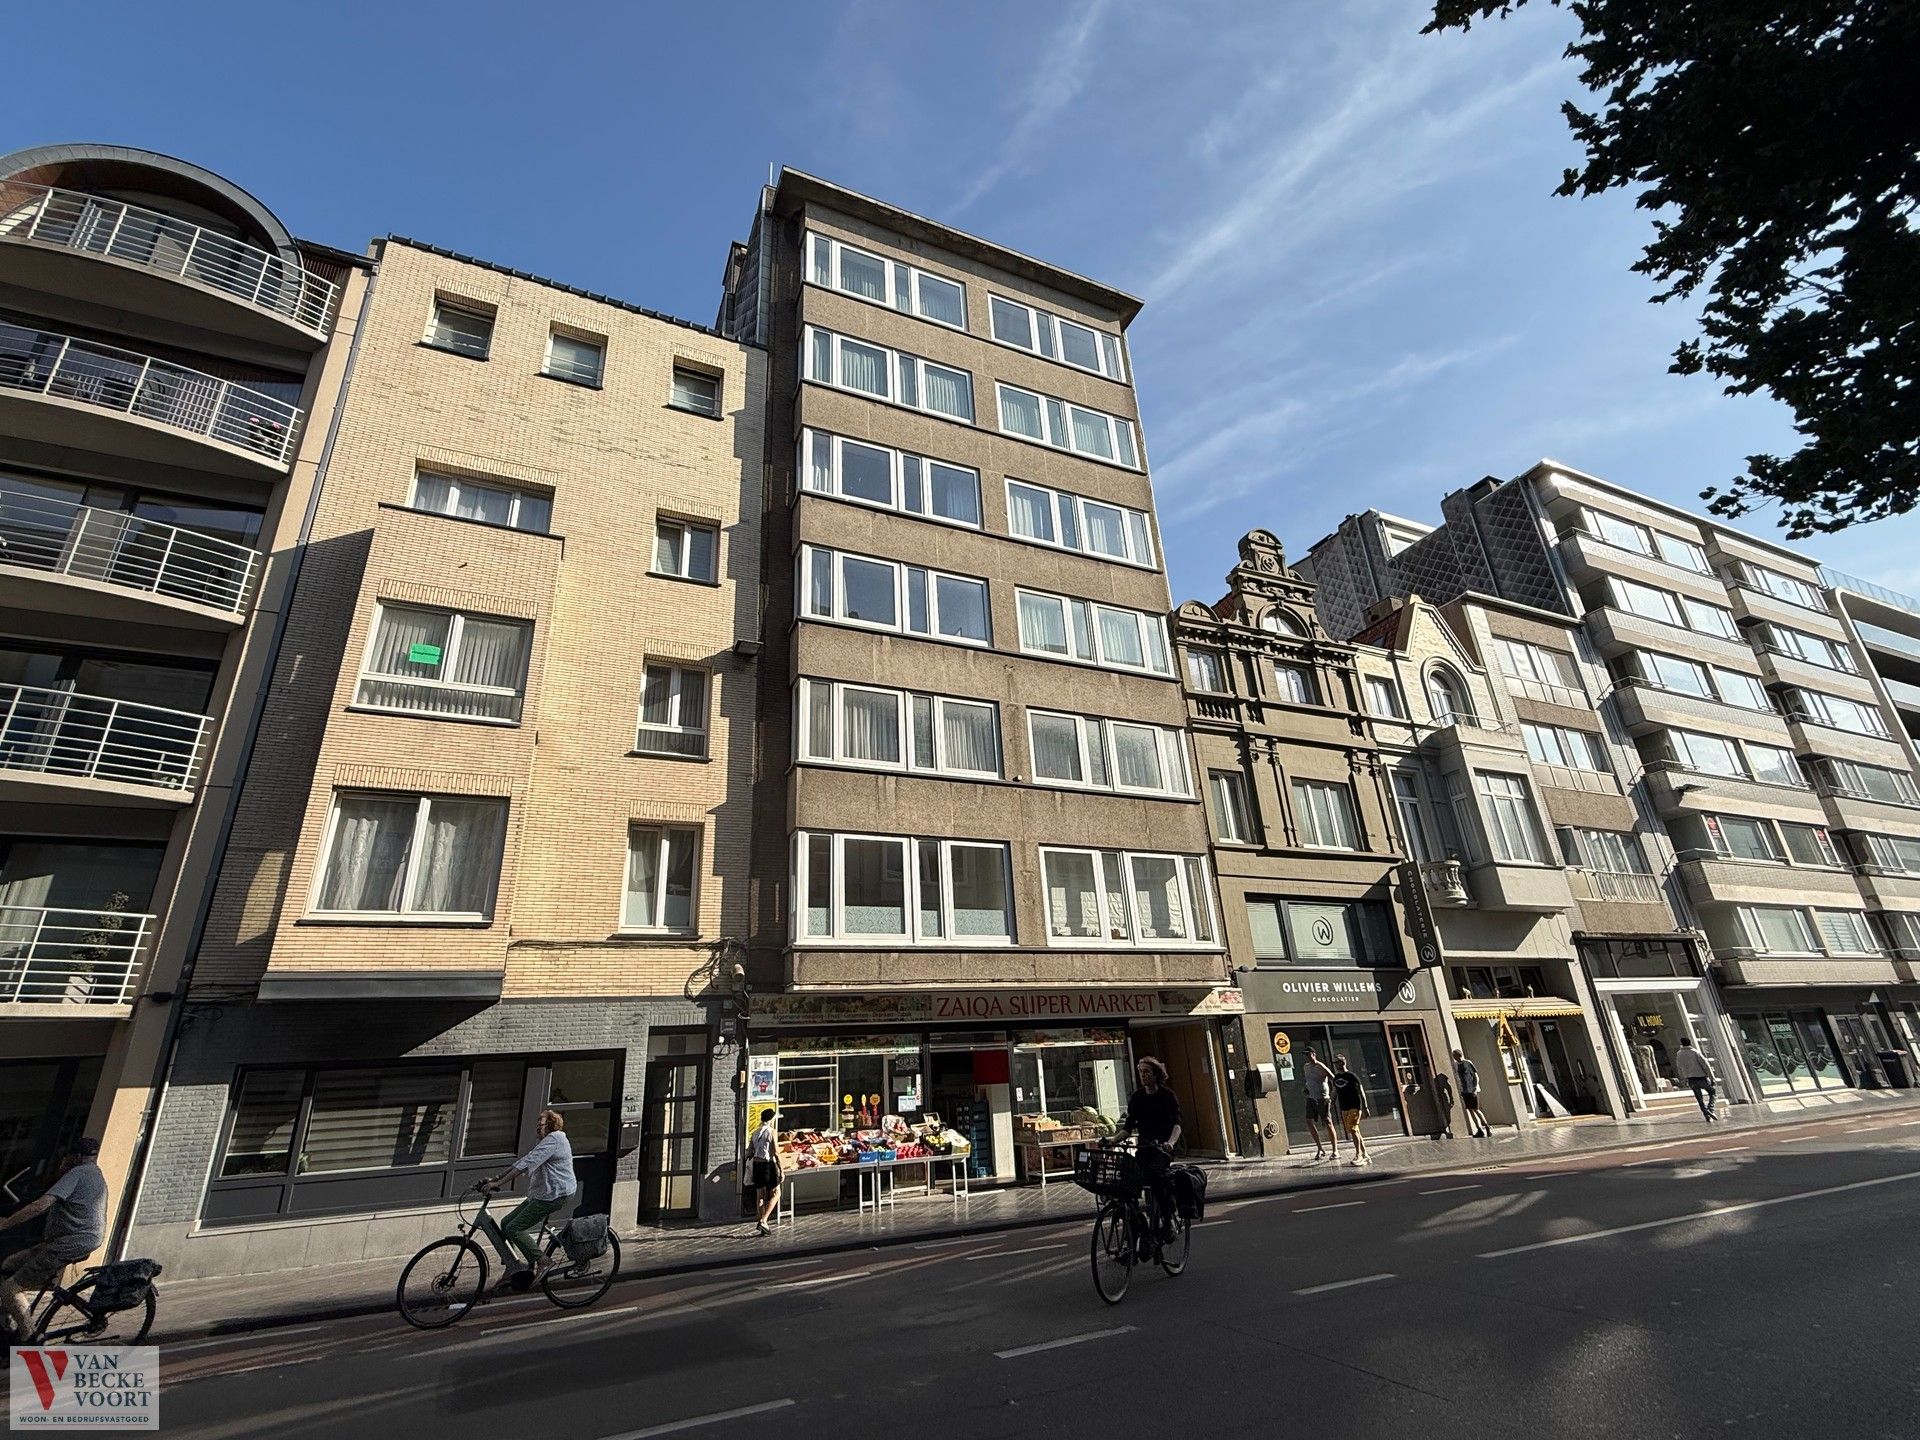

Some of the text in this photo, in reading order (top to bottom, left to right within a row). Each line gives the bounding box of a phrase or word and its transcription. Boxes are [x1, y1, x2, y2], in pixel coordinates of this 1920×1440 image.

[1407, 870, 1428, 939] CHOCOLATERIE
[1282, 982, 1382, 993] OLIVIER WILLEMS
[936, 992, 1156, 1018] ZAIQA SUPER MARKET
